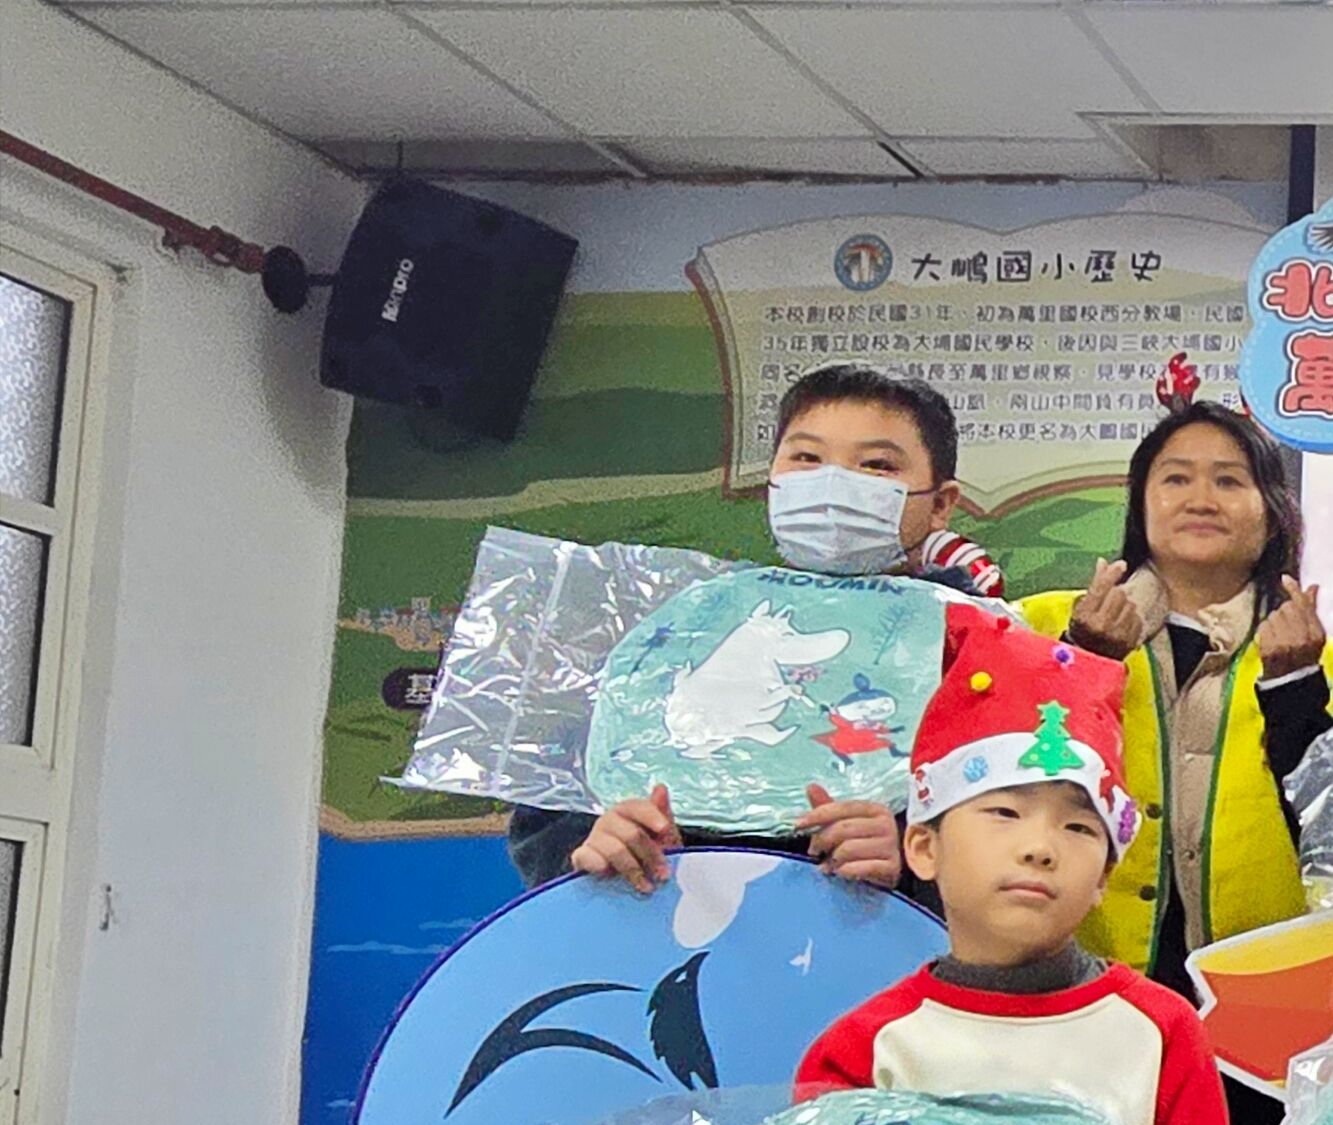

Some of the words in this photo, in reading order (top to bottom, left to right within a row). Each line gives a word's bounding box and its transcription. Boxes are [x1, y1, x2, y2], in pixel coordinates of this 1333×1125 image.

[911, 249, 1162, 284] 大鵬國小歷史
